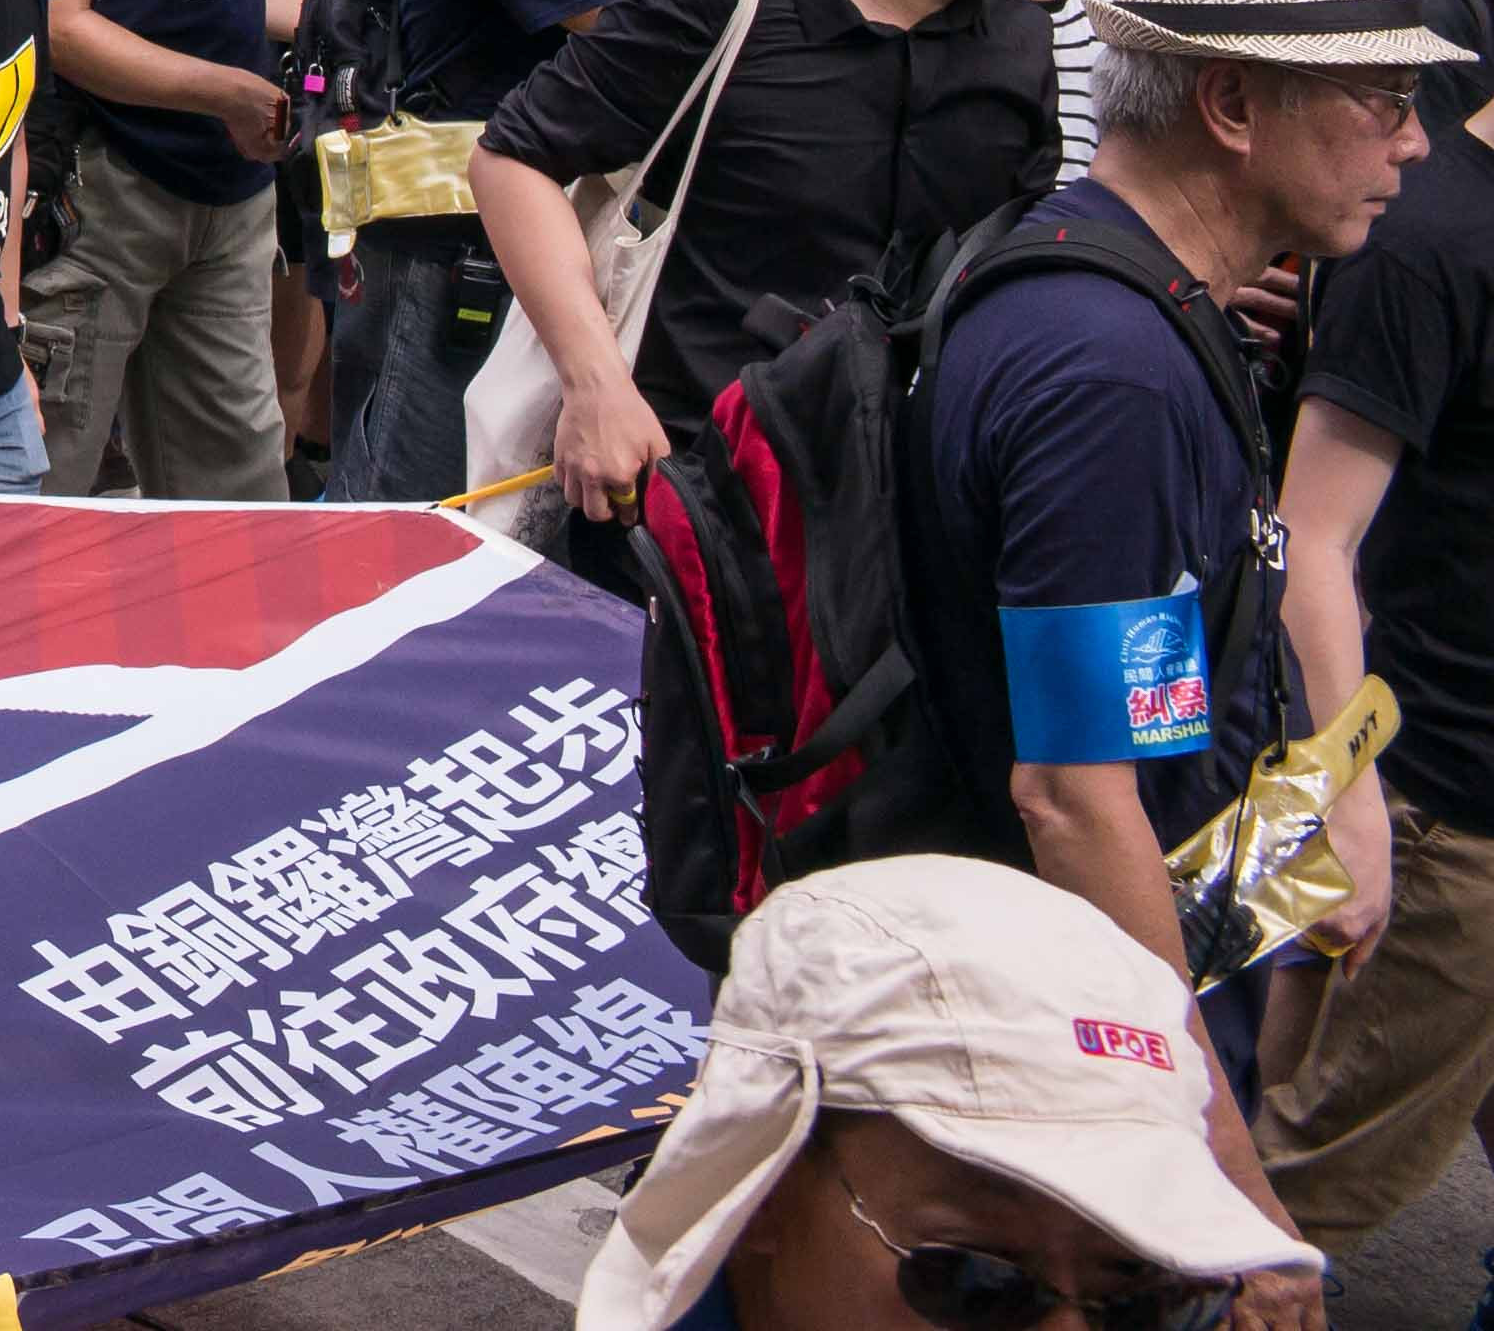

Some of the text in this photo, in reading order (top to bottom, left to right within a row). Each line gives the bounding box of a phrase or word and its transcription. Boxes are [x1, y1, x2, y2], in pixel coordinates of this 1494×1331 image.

[1128, 677, 1209, 728] 糾察
[1132, 719, 1210, 746] MARSHAL
[1347, 710, 1379, 756] HYT
[17, 676, 643, 1043] 由銅鑼灣起步
